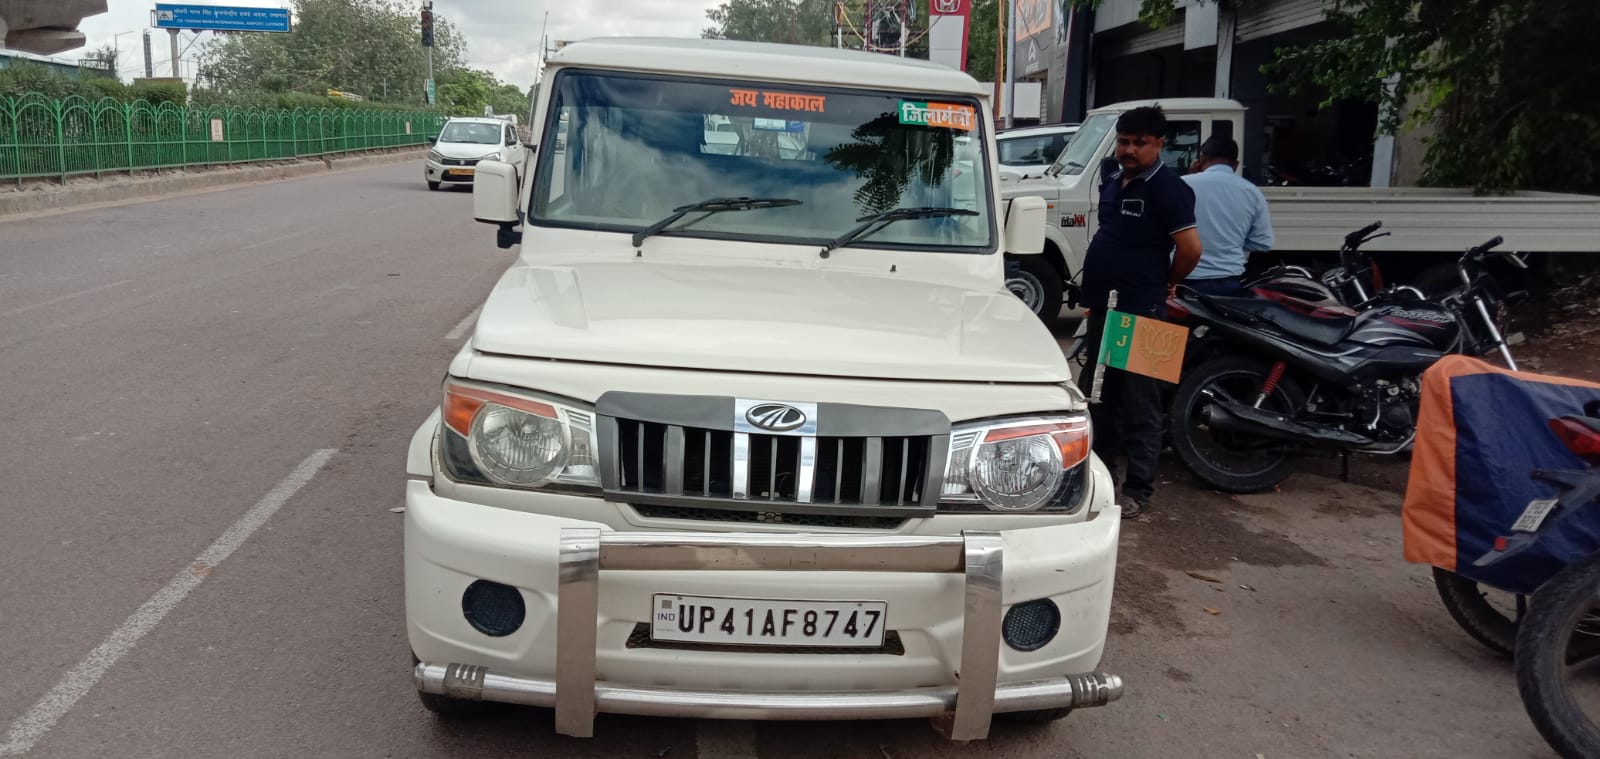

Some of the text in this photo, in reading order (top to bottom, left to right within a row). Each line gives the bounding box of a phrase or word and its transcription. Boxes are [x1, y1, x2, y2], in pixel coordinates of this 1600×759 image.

[730, 89, 826, 112] जय महाकाल
[657, 605, 881, 638] IND UP41AF8747
